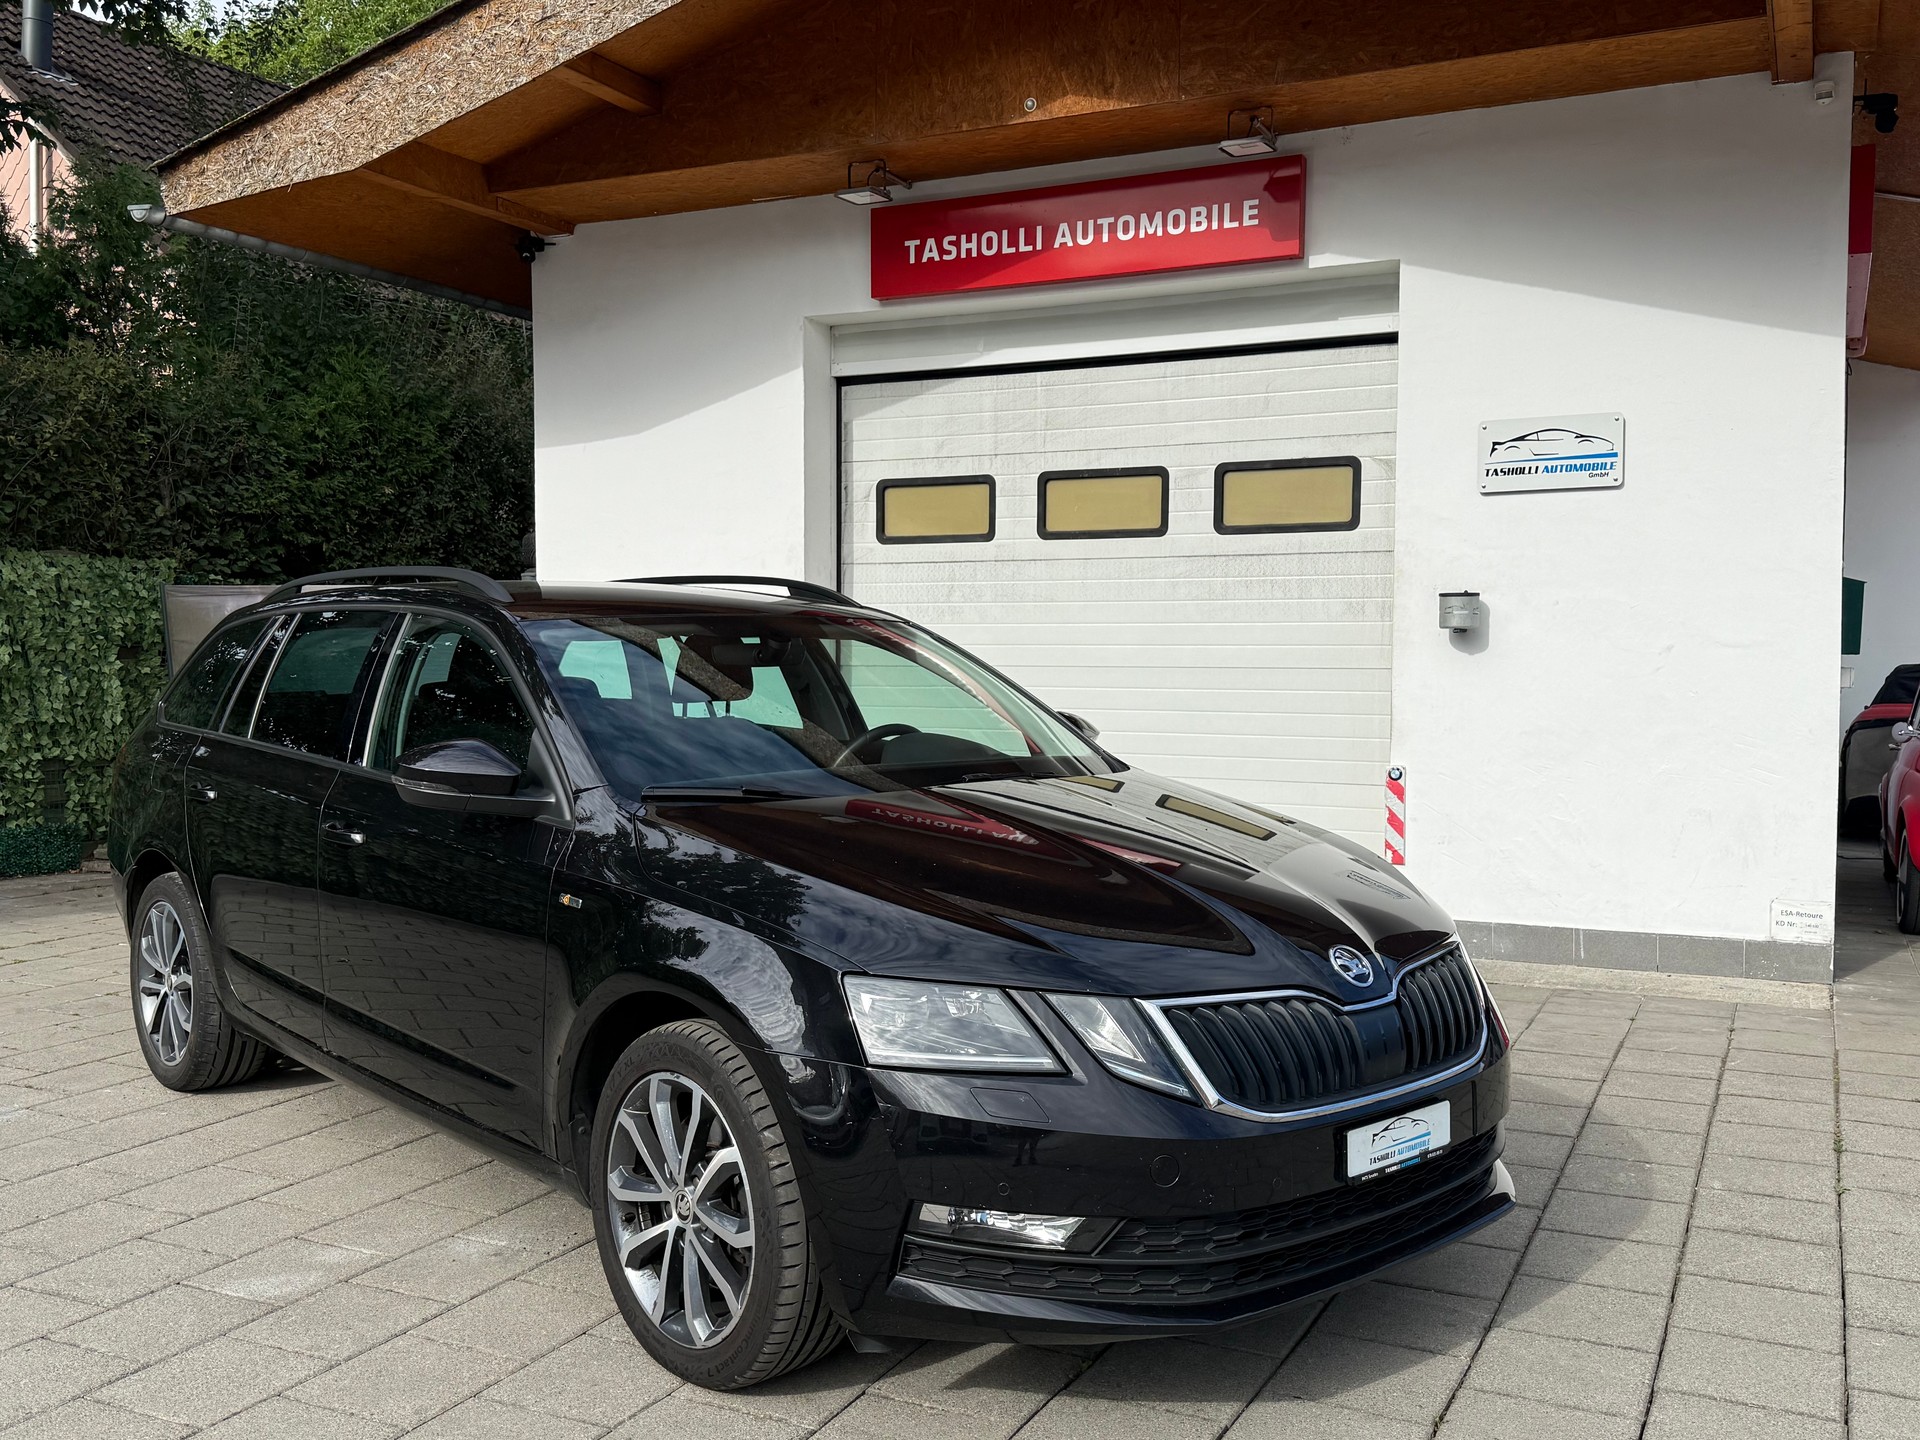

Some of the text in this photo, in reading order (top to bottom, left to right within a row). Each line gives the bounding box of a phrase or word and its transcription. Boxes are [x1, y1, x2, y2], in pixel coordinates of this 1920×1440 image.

[904, 199, 1260, 264] TASHOLLI AUTOMOBILE
[1485, 461, 1618, 477] TASHOLLI AUTOMOBILE
[1780, 909, 1824, 920] ESA-Retoure
